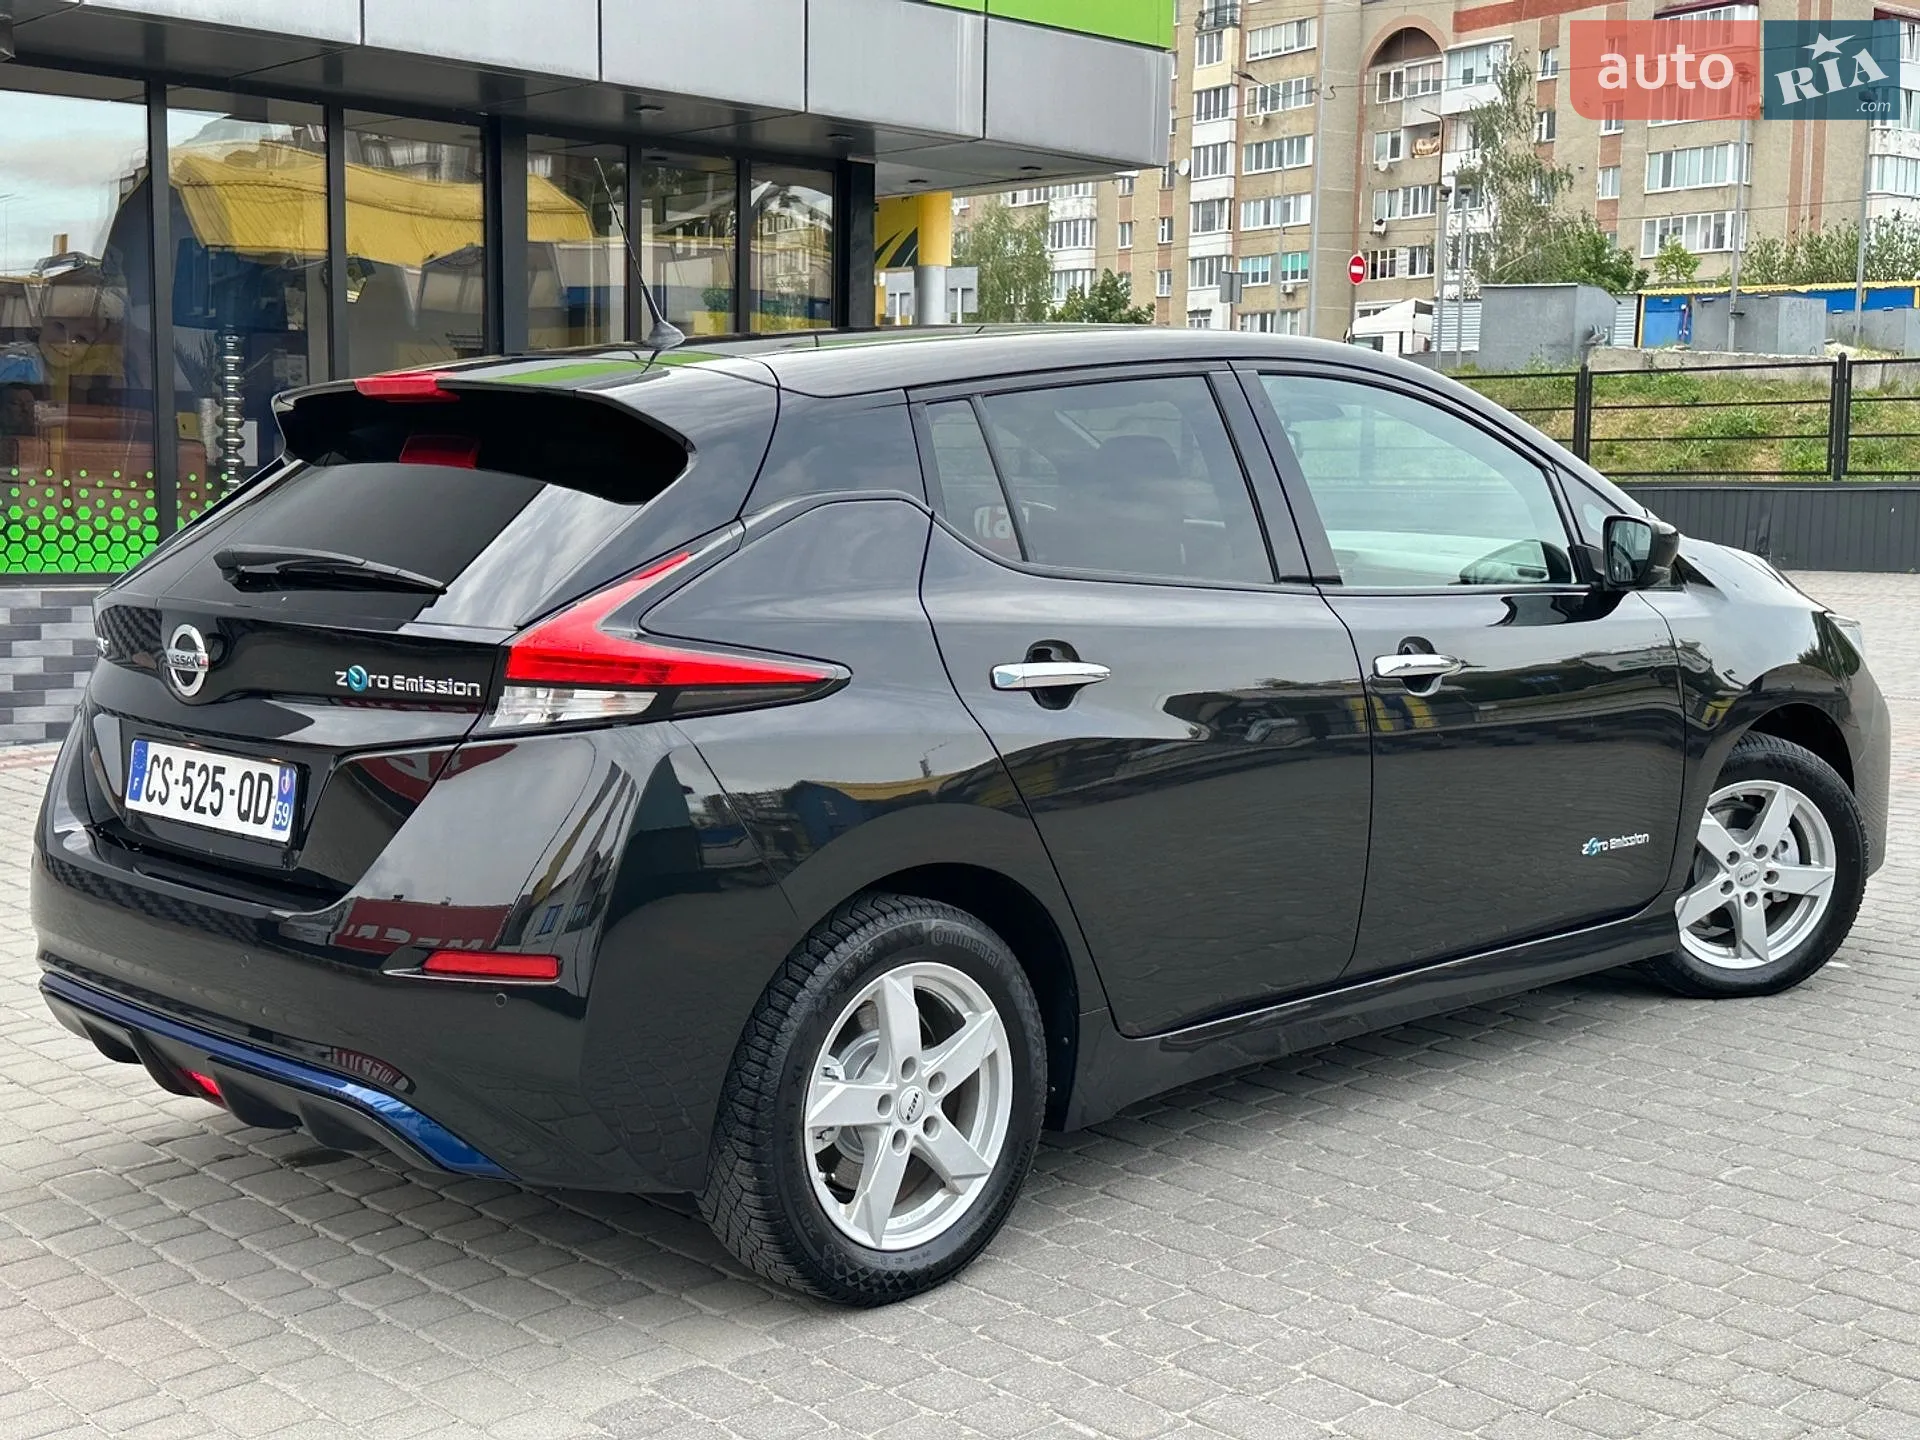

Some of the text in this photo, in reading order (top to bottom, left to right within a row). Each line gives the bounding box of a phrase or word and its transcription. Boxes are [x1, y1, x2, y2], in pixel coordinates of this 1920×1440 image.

[392, 674, 481, 698] Emission
[131, 777, 140, 793] F
[144, 753, 275, 826] CS-525-QD
[273, 801, 290, 827] 59
[1609, 832, 1650, 850] Emission
[930, 924, 1000, 969] Continental
